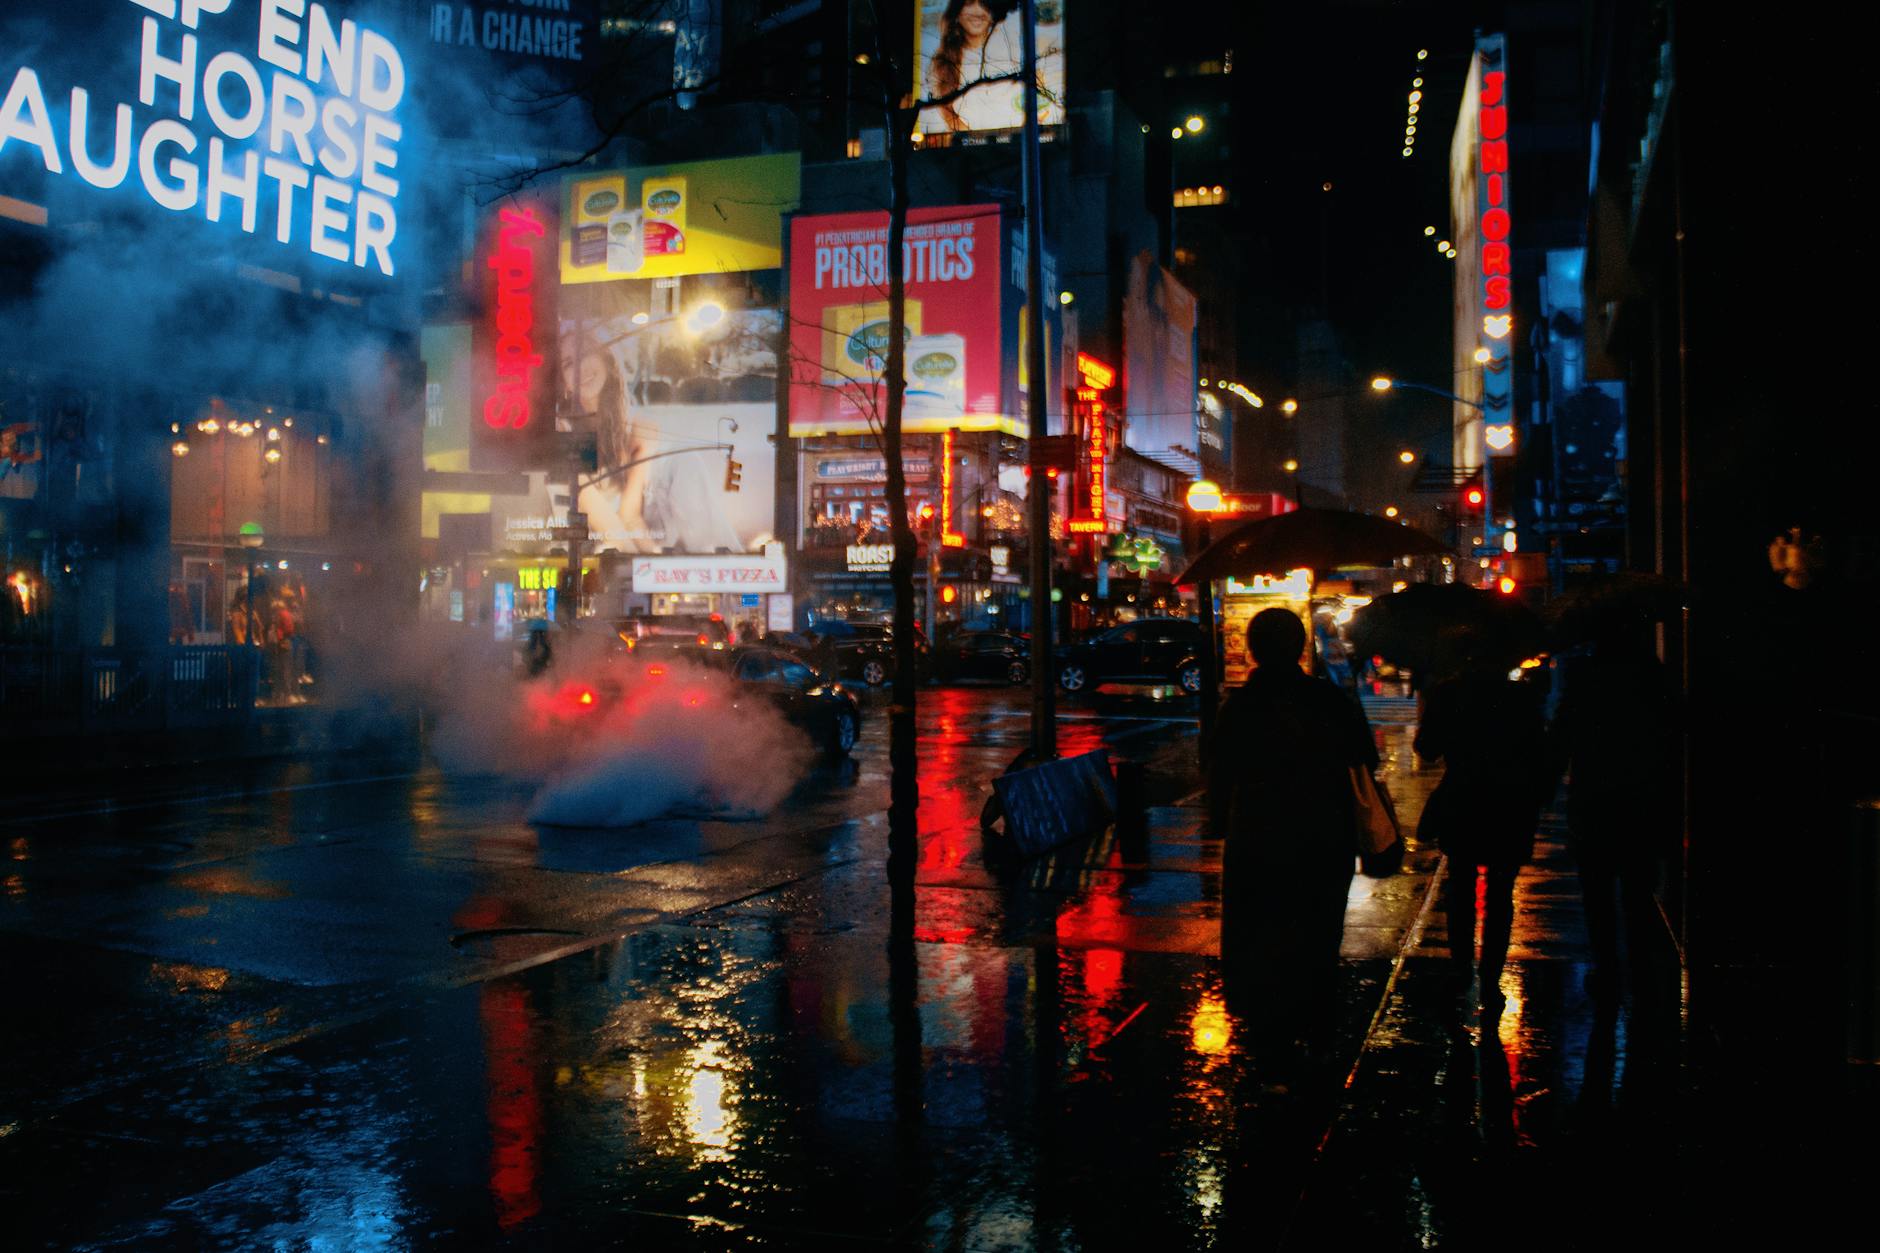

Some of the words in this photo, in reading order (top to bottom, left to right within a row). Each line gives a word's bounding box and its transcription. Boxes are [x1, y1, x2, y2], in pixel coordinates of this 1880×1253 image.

[458, 8, 475, 47] A
[482, 11, 583, 61] CHANGE
[259, 0, 404, 113] END
[139, 16, 402, 198] HORSE
[1480, 71, 1511, 310] JUNIORS
[1077, 389, 1097, 400] THE
[1069, 521, 1104, 532] TAVERN
[519, 567, 540, 589] THE
[655, 568, 712, 584] RAY'S
[716, 568, 779, 584] PIZZA
